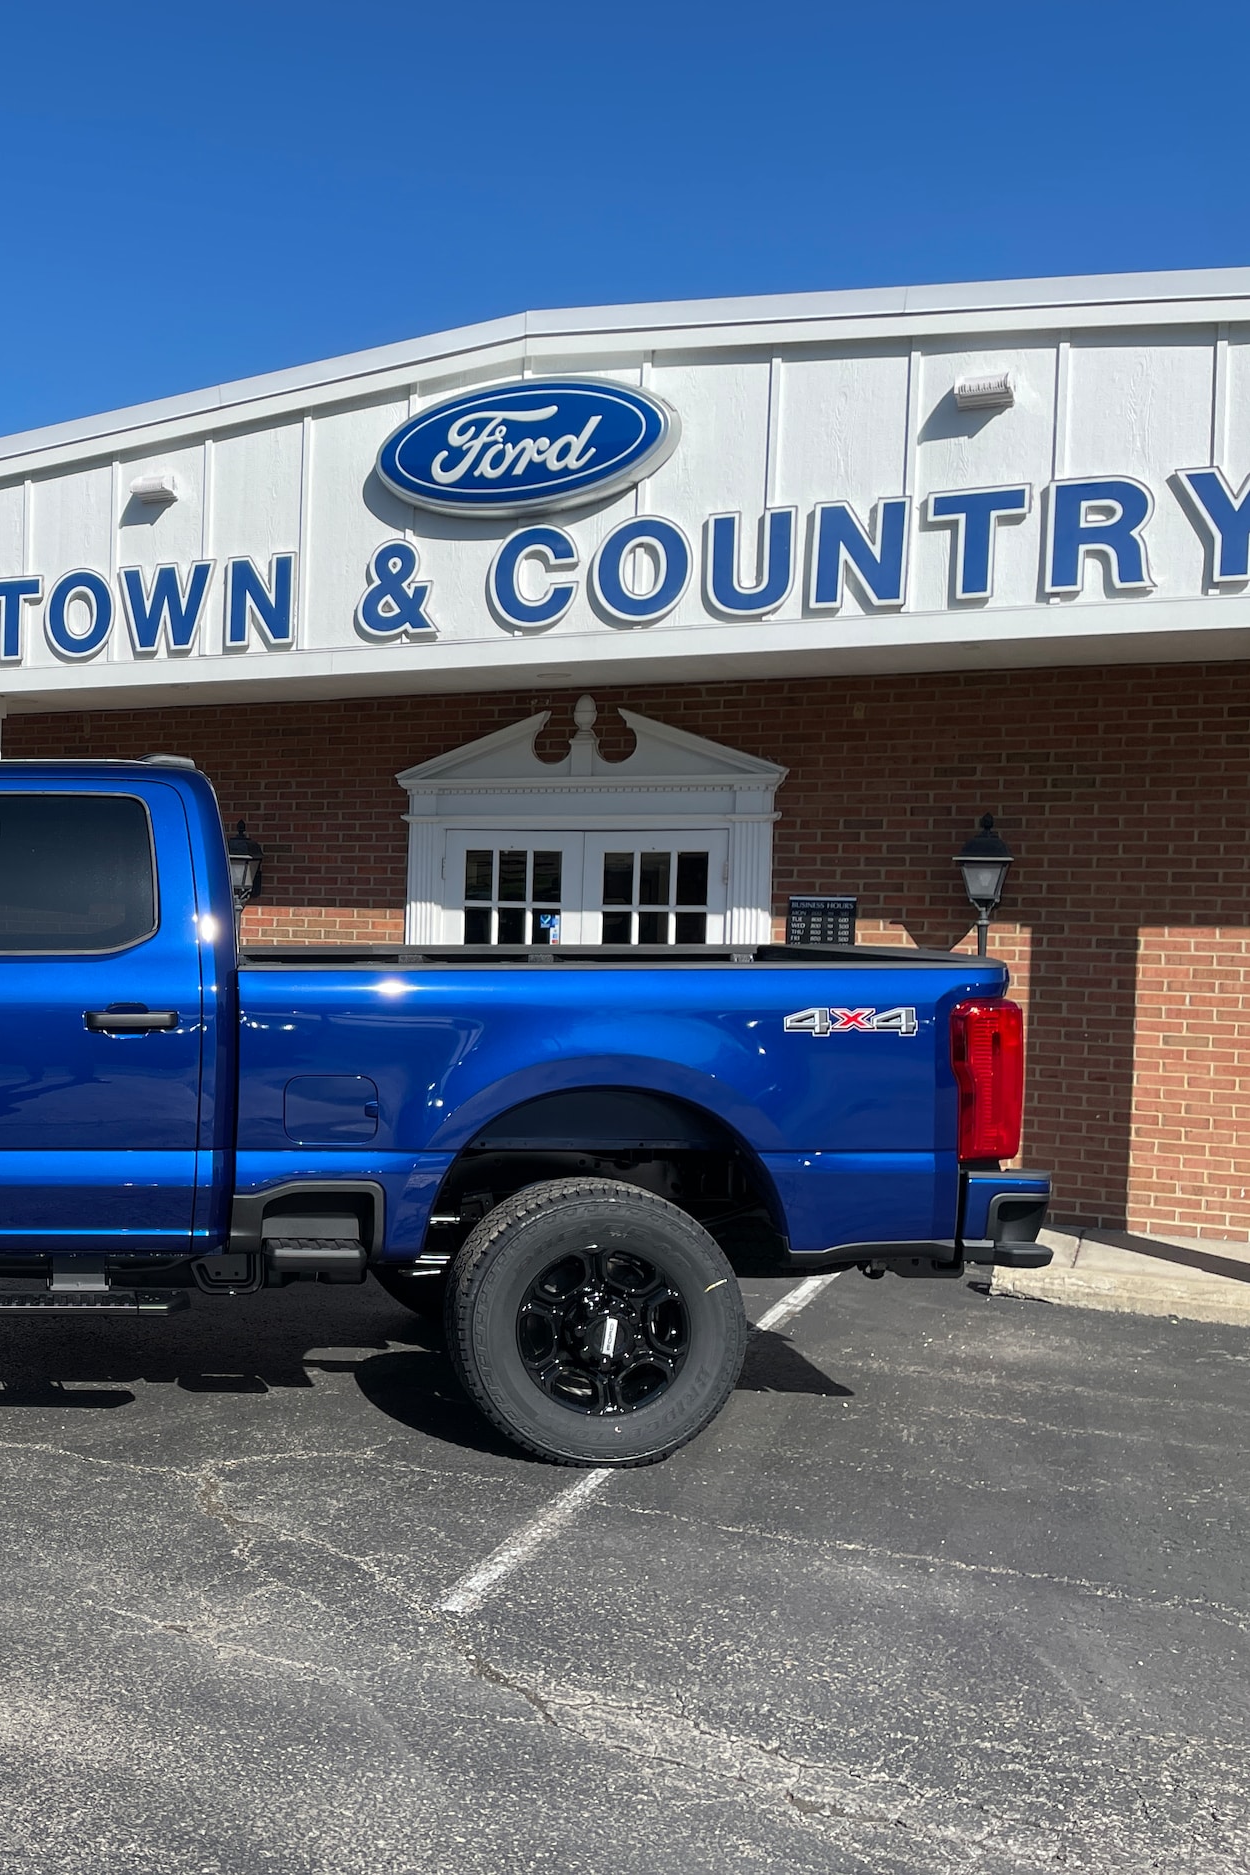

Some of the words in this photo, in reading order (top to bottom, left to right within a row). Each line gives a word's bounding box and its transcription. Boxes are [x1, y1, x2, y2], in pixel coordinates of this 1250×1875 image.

[431, 405, 603, 484] Ford
[358, 539, 437, 641] &
[490, 466, 1250, 629] COUNTRY
